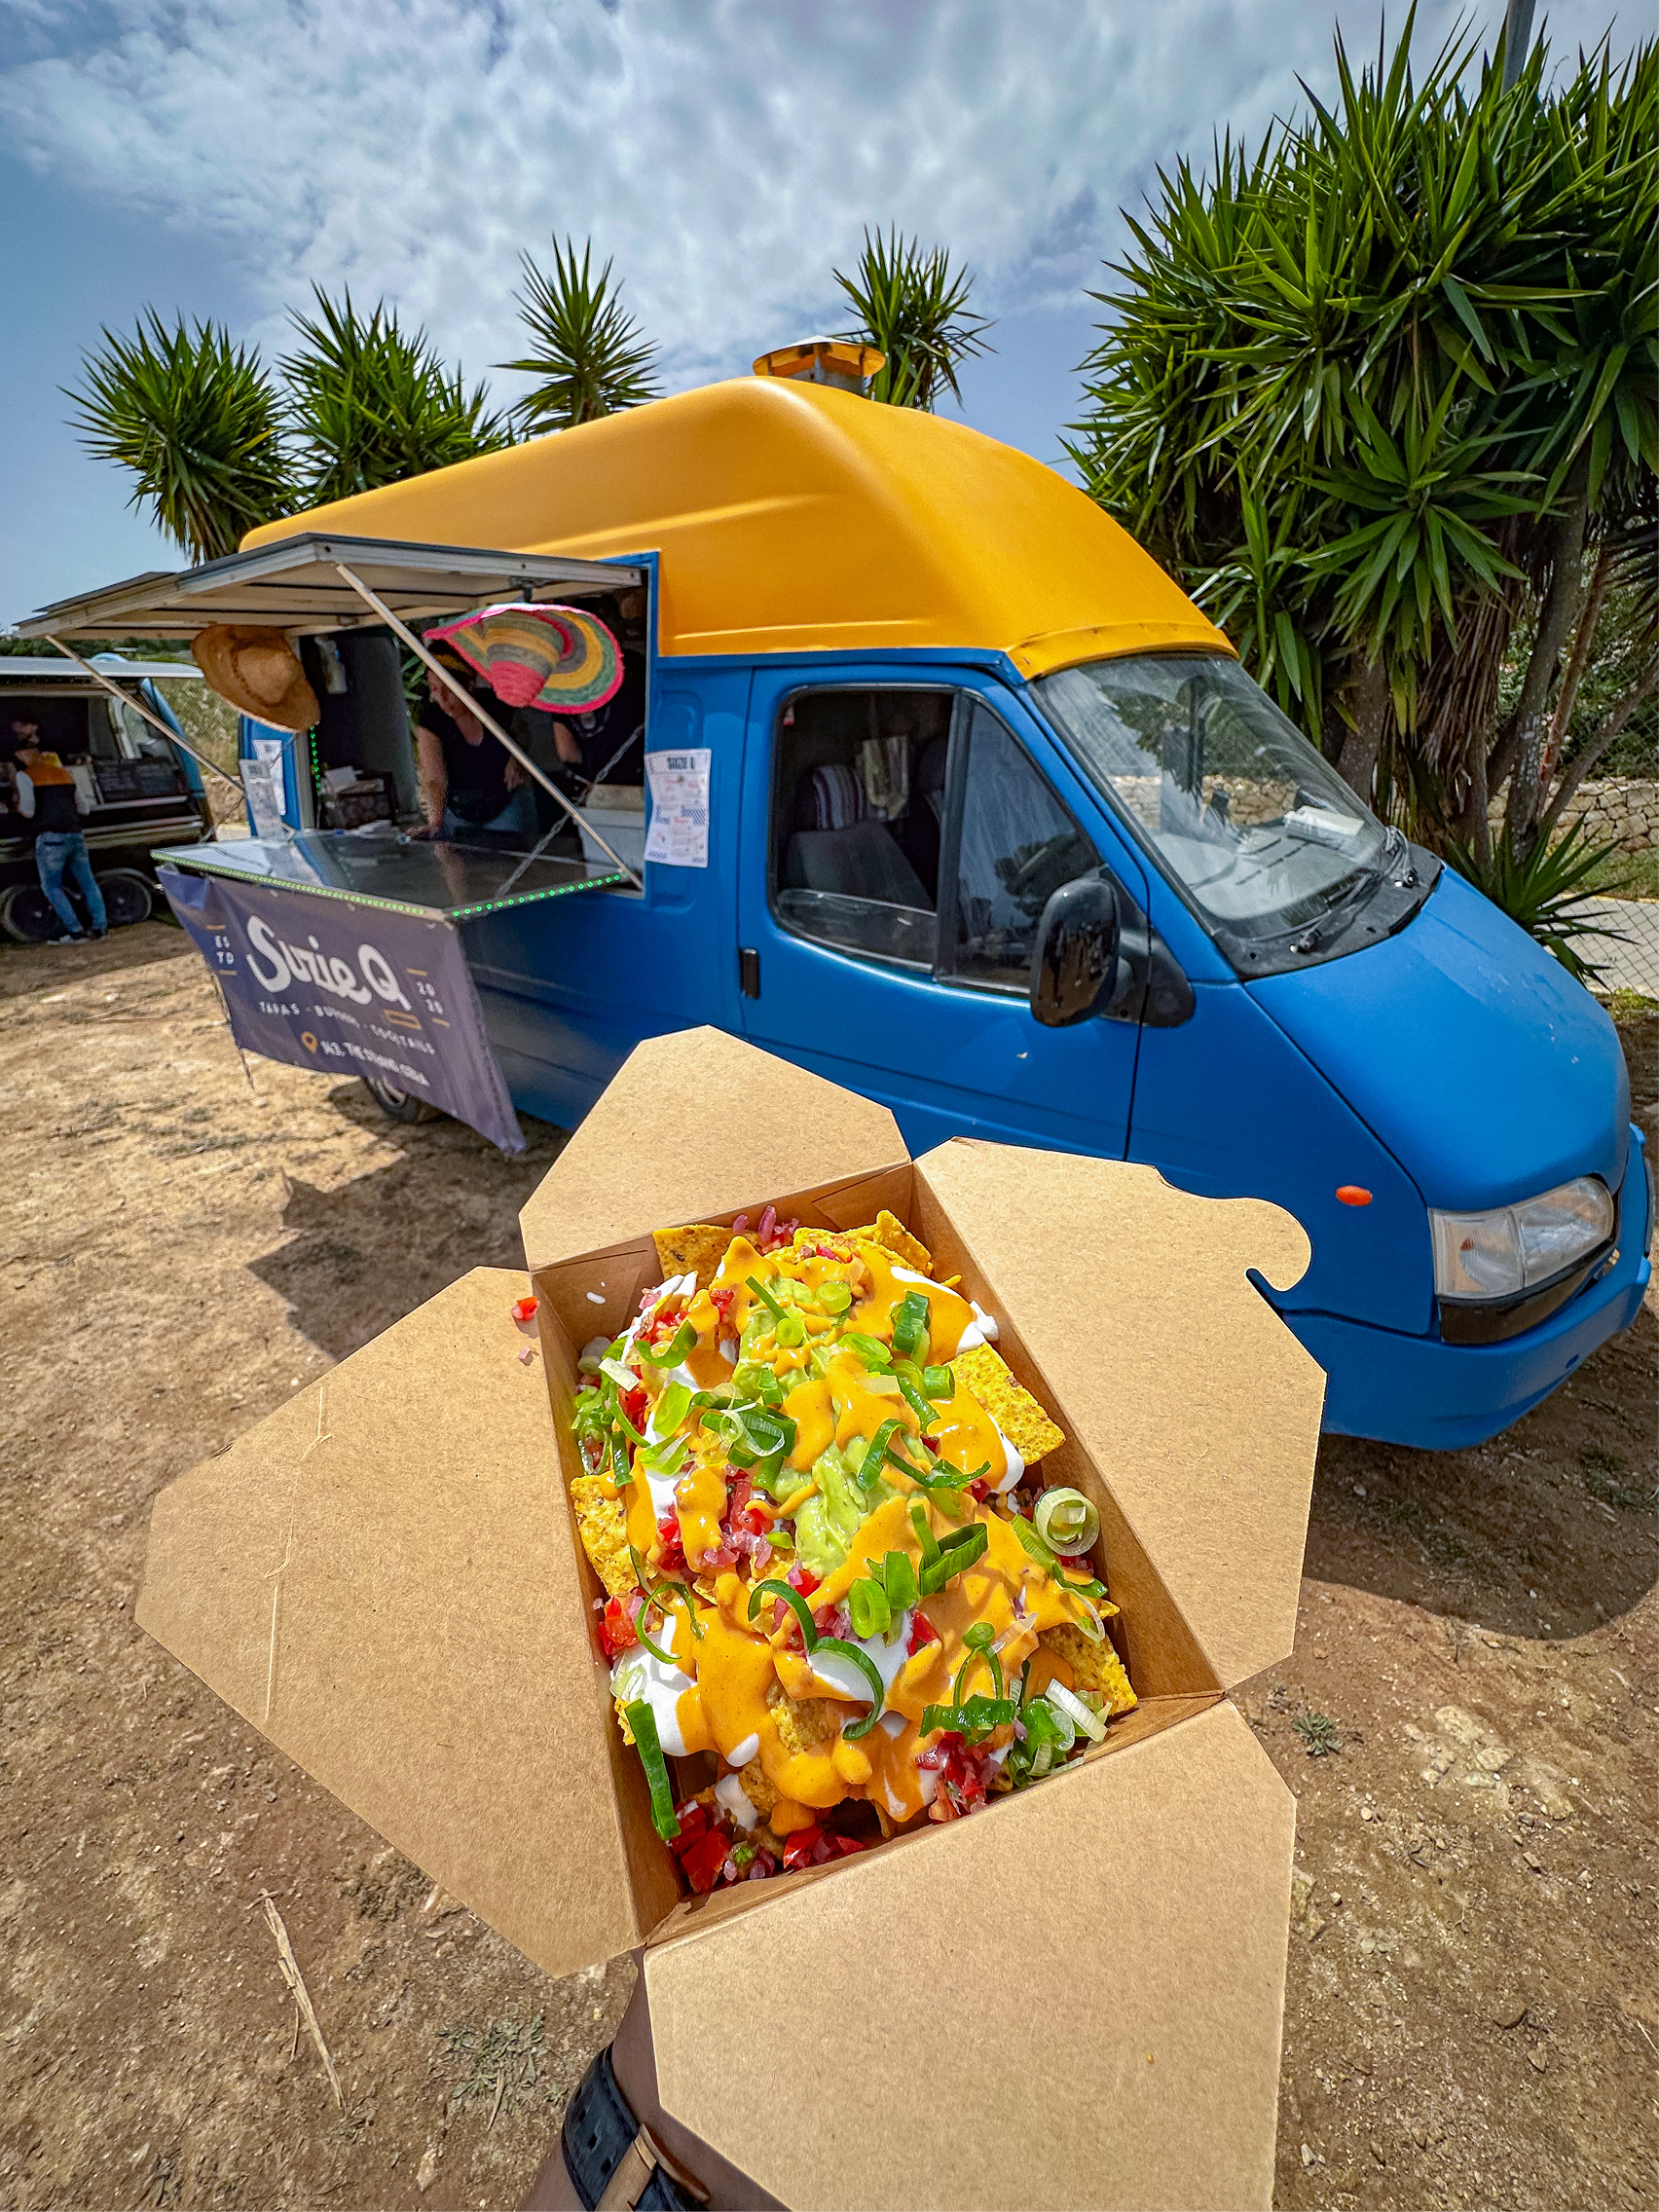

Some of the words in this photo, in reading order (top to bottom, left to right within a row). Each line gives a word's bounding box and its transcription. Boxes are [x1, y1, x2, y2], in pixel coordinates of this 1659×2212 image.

[358, 943, 412, 1012] Q
[416, 980, 435, 997] 20
[259, 1001, 300, 1015] TAPAS
[424, 998, 443, 1014] 20
